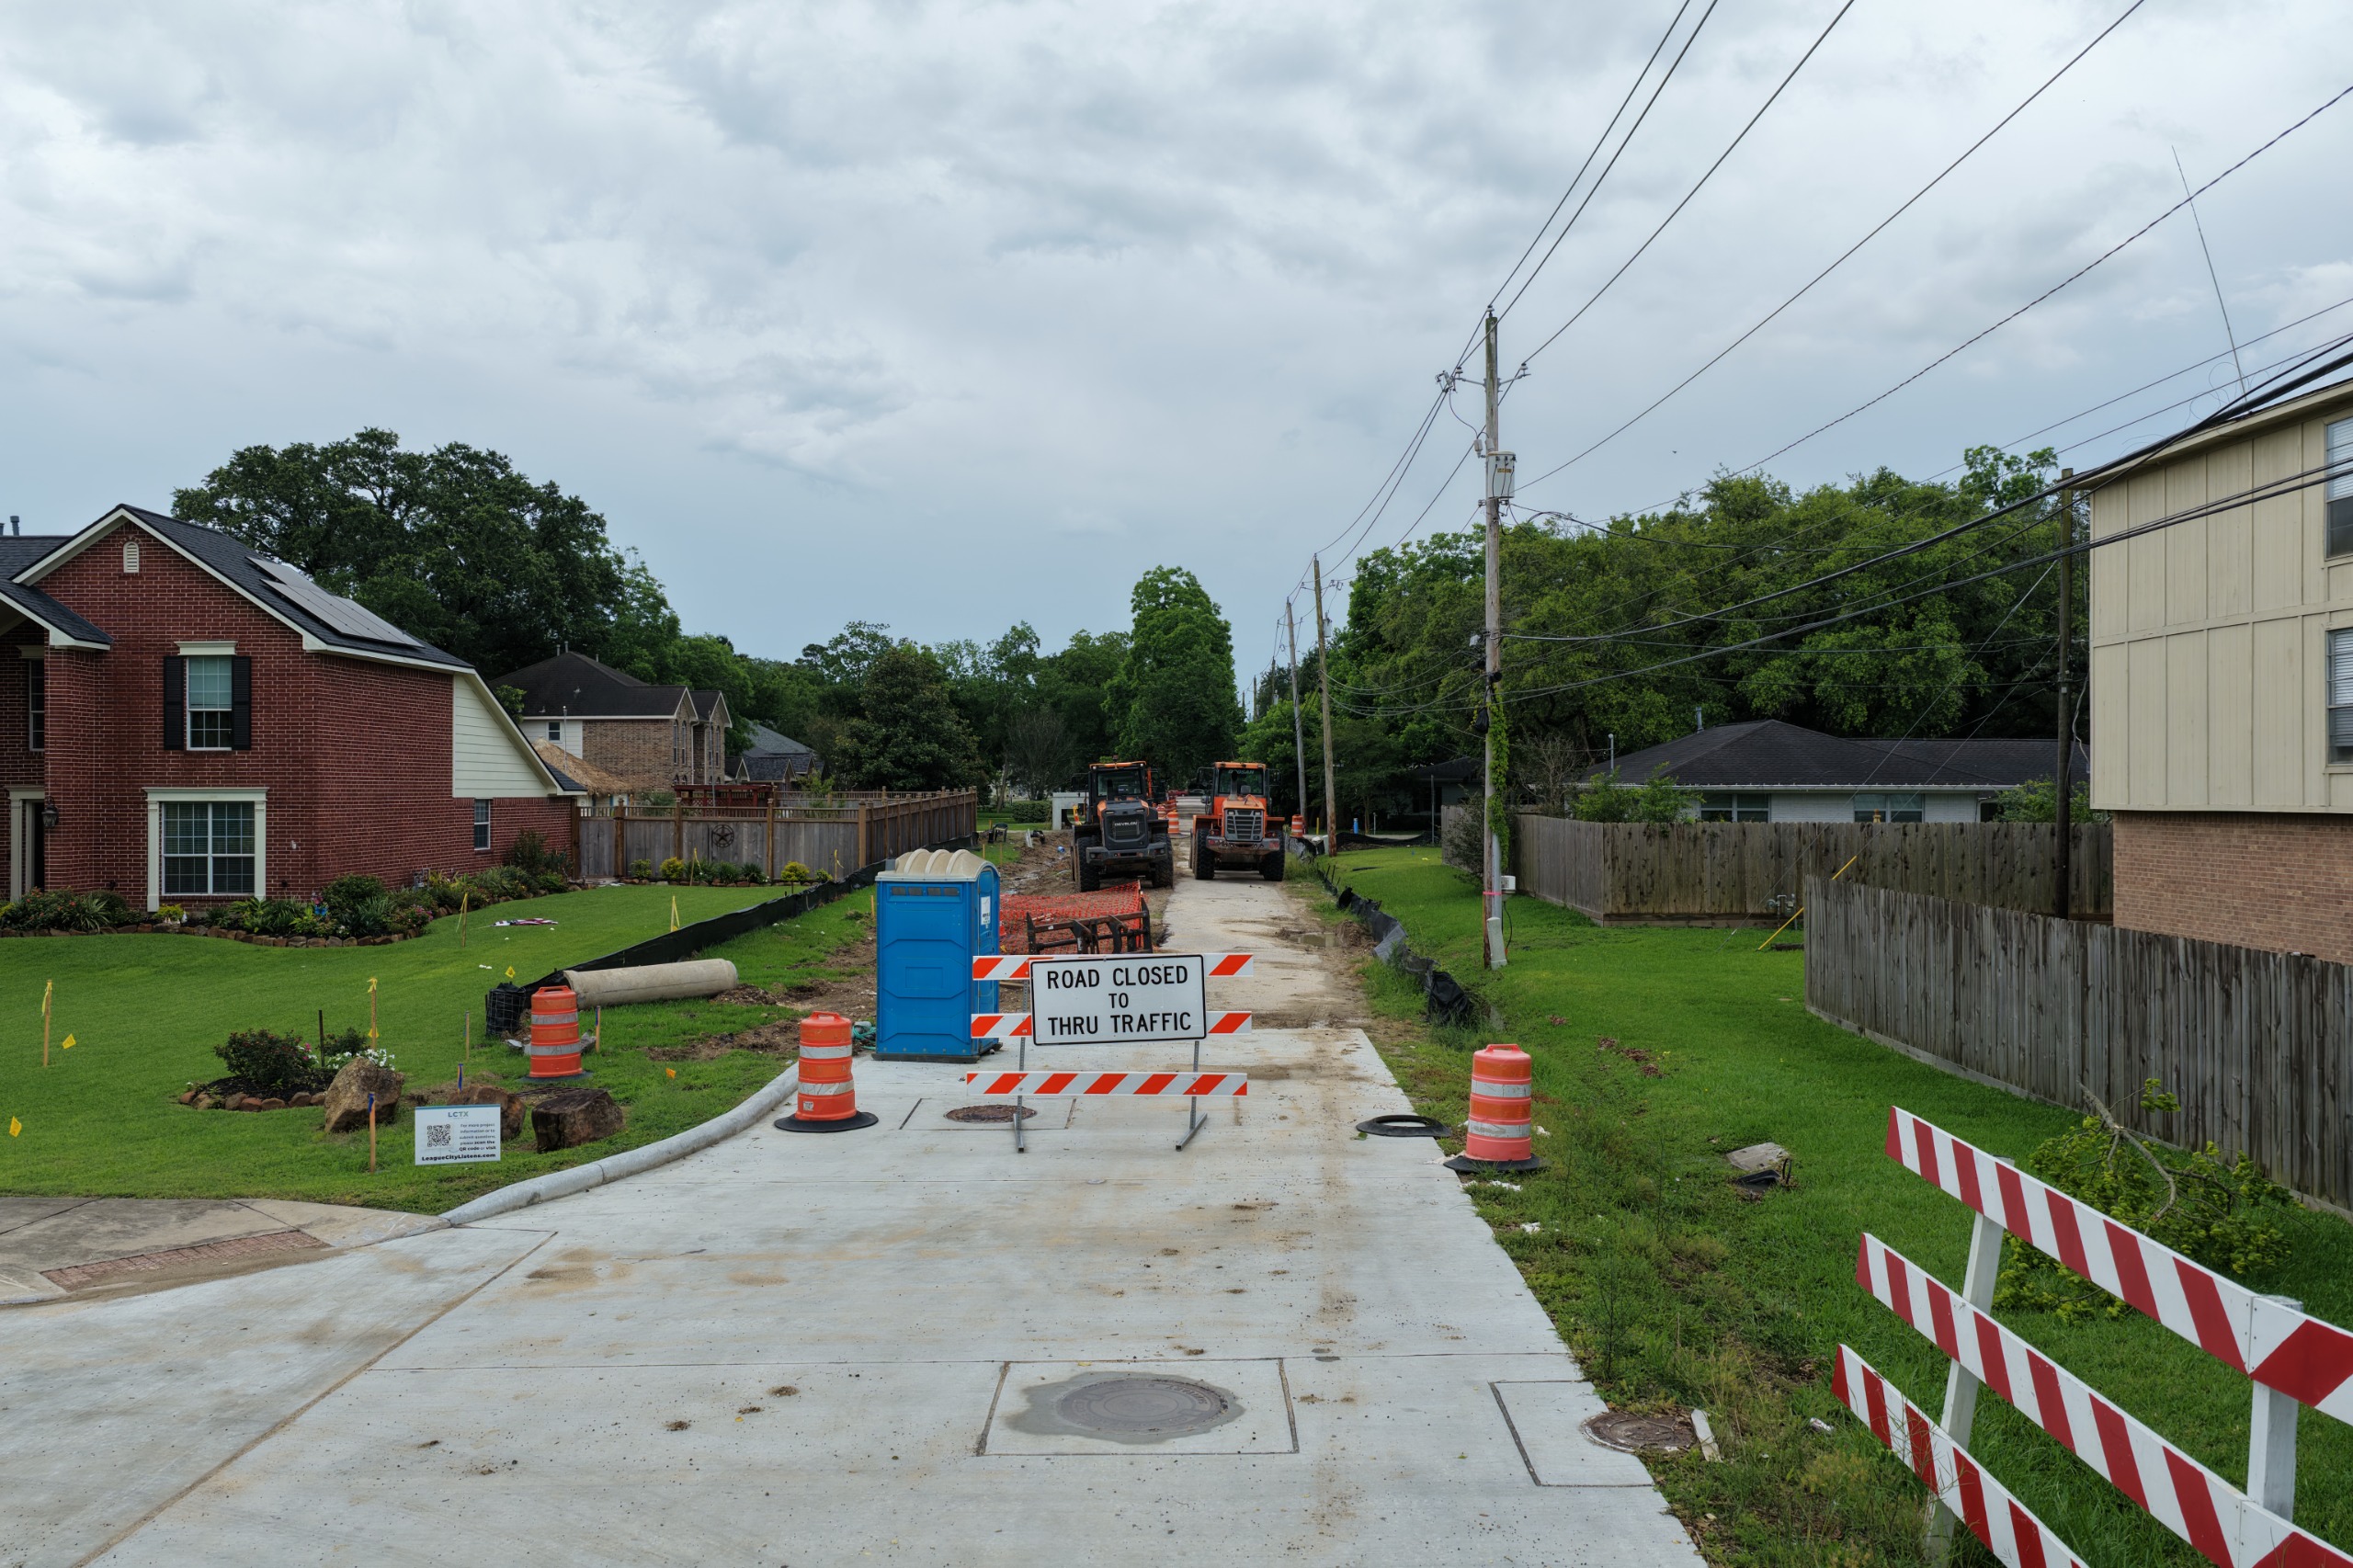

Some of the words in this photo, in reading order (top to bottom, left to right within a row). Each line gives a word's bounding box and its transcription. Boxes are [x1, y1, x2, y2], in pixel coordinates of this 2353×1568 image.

[1047, 969, 1100, 989] ROAD
[1113, 965, 1188, 986] CLOSED
[1108, 993, 1130, 1008] TO
[1048, 1016, 1098, 1036] THRU
[1110, 1012, 1191, 1033] TRAFFIC
